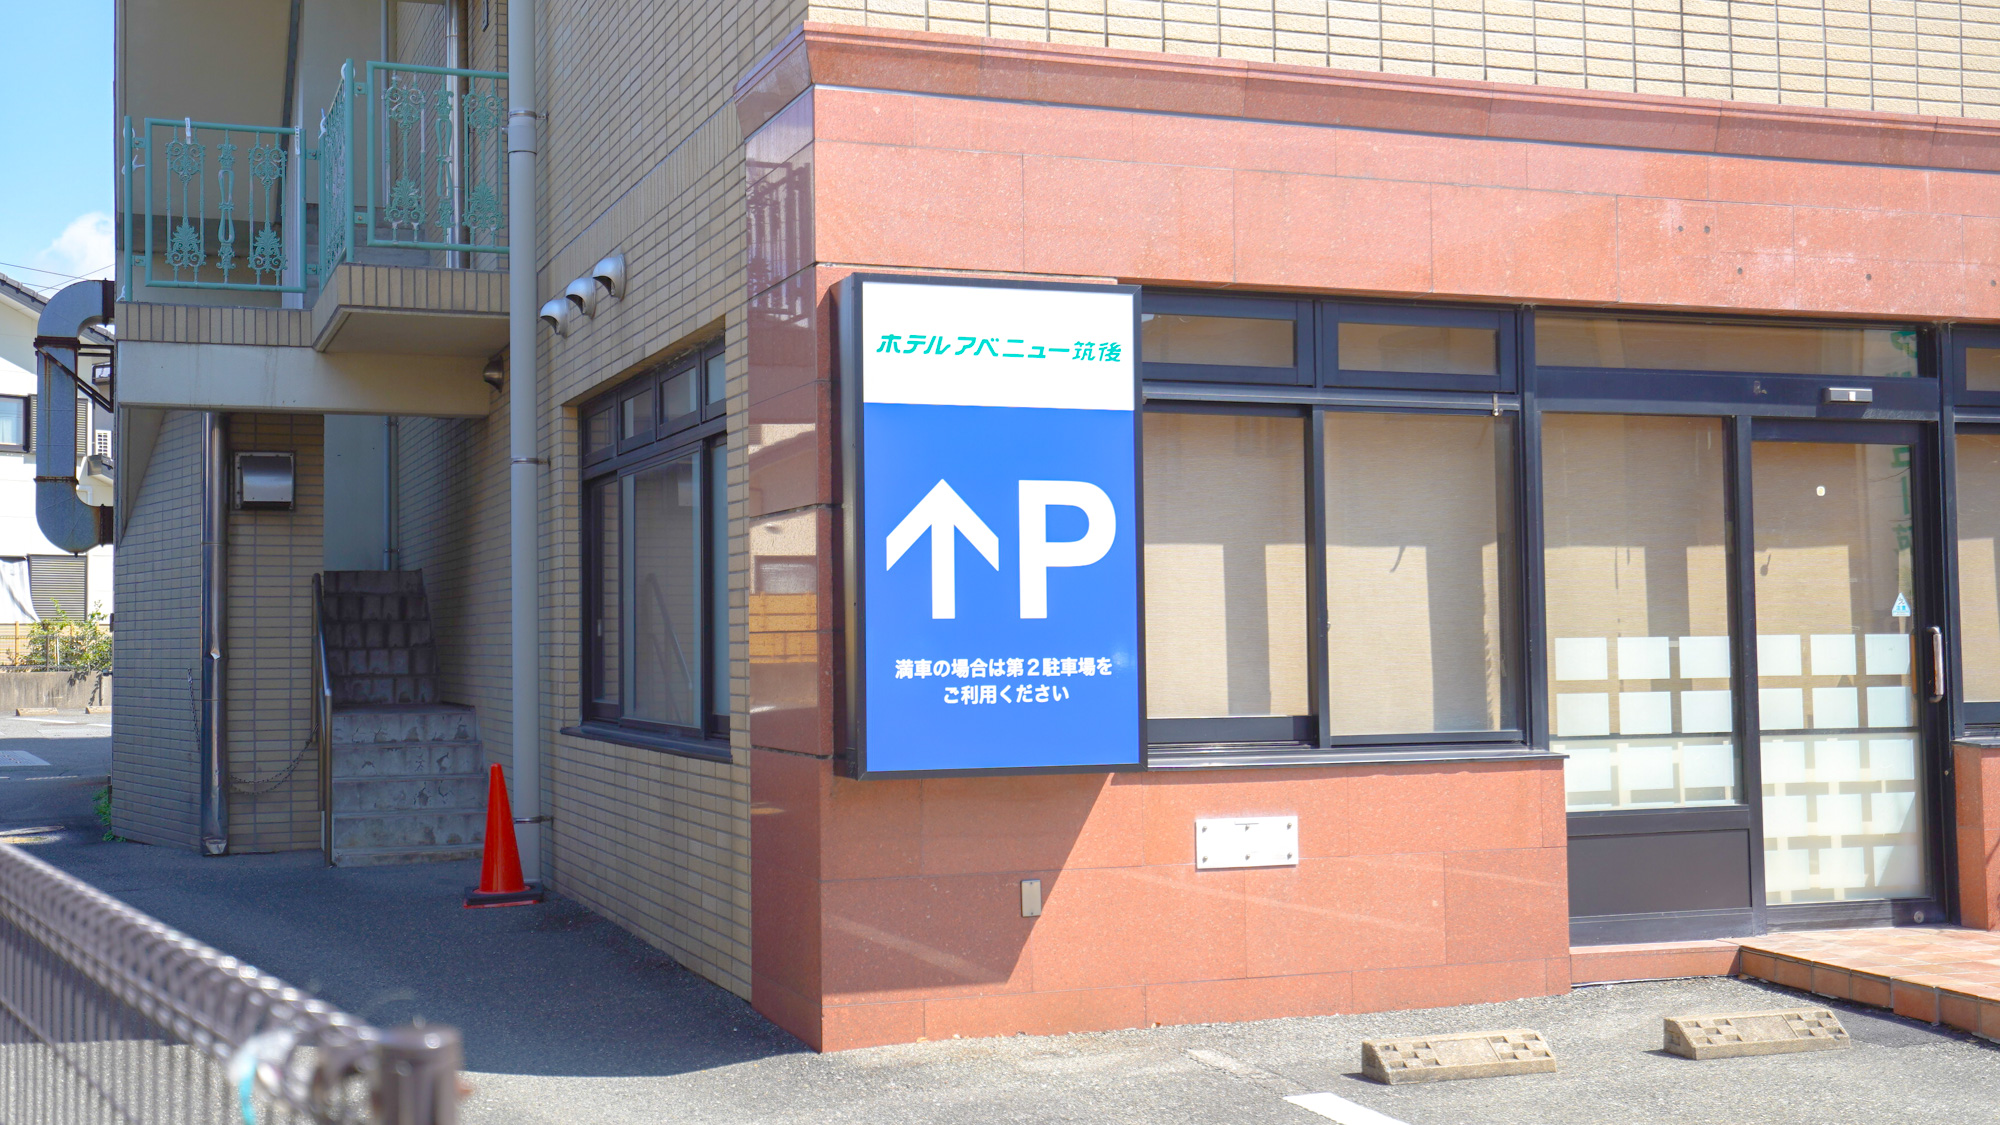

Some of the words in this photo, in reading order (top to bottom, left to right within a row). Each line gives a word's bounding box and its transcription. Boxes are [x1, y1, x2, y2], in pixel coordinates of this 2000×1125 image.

[876, 333, 1122, 363] ホテルアベニュー筑後
[1018, 479, 1117, 620] P
[895, 656, 1113, 680] 満車の場合は第2駐車場を
[943, 683, 1070, 706] ご利用ください
